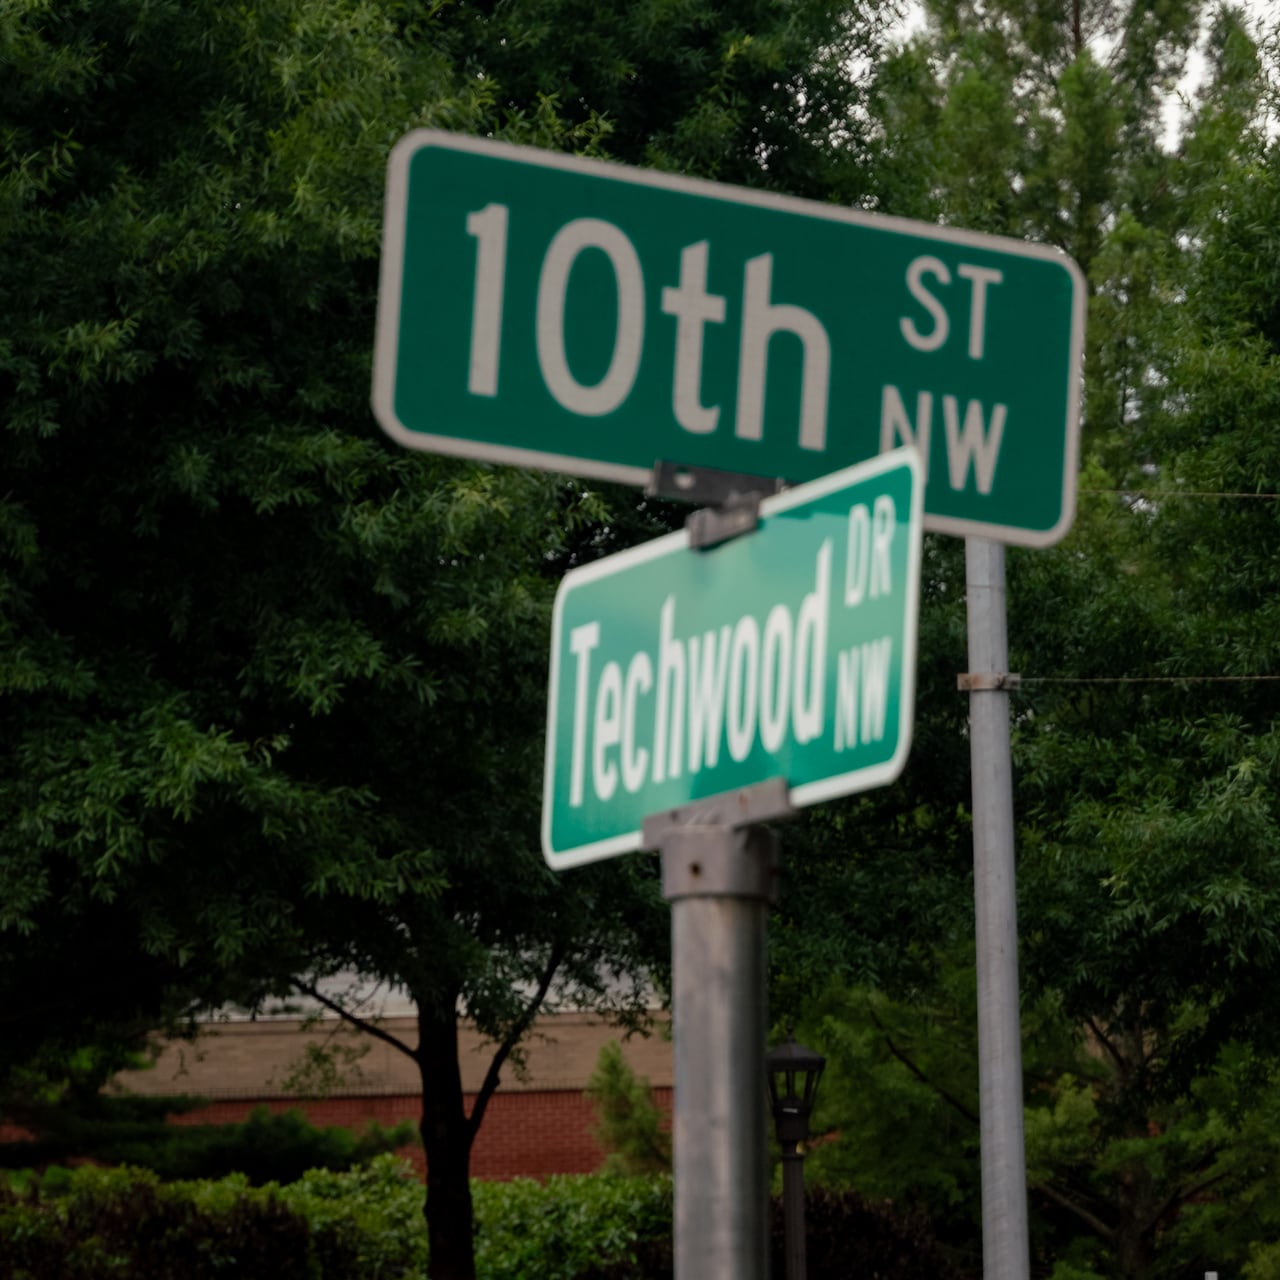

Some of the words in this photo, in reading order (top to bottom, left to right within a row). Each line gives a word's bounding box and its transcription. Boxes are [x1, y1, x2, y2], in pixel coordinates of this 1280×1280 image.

[466, 203, 831, 451] 10th
[900, 255, 1003, 359] ST
[879, 384, 1007, 495] NW
[569, 537, 833, 808] Techwood
[845, 494, 897, 607] DR
[833, 635, 891, 752] NW
